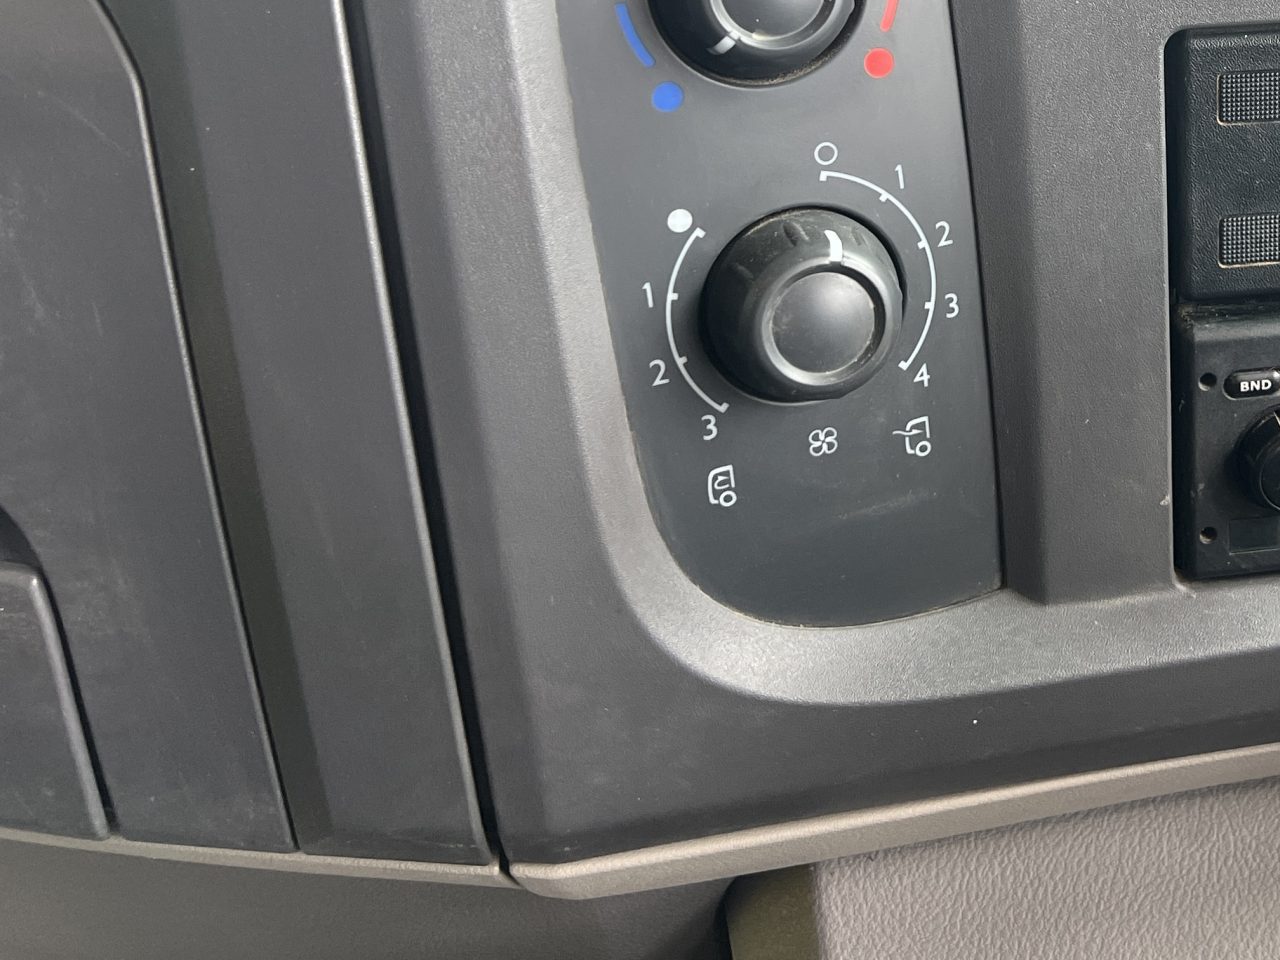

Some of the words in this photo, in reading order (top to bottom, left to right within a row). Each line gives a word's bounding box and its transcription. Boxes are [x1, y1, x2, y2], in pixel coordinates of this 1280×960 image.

[894, 164, 905, 189] 1
[935, 221, 953, 247] 2
[642, 282, 654, 308] 1
[944, 294, 959, 318] 3
[649, 359, 669, 387] 2
[913, 363, 931, 387] 4
[1240, 379, 1272, 392] BND
[701, 414, 718, 441] 3
